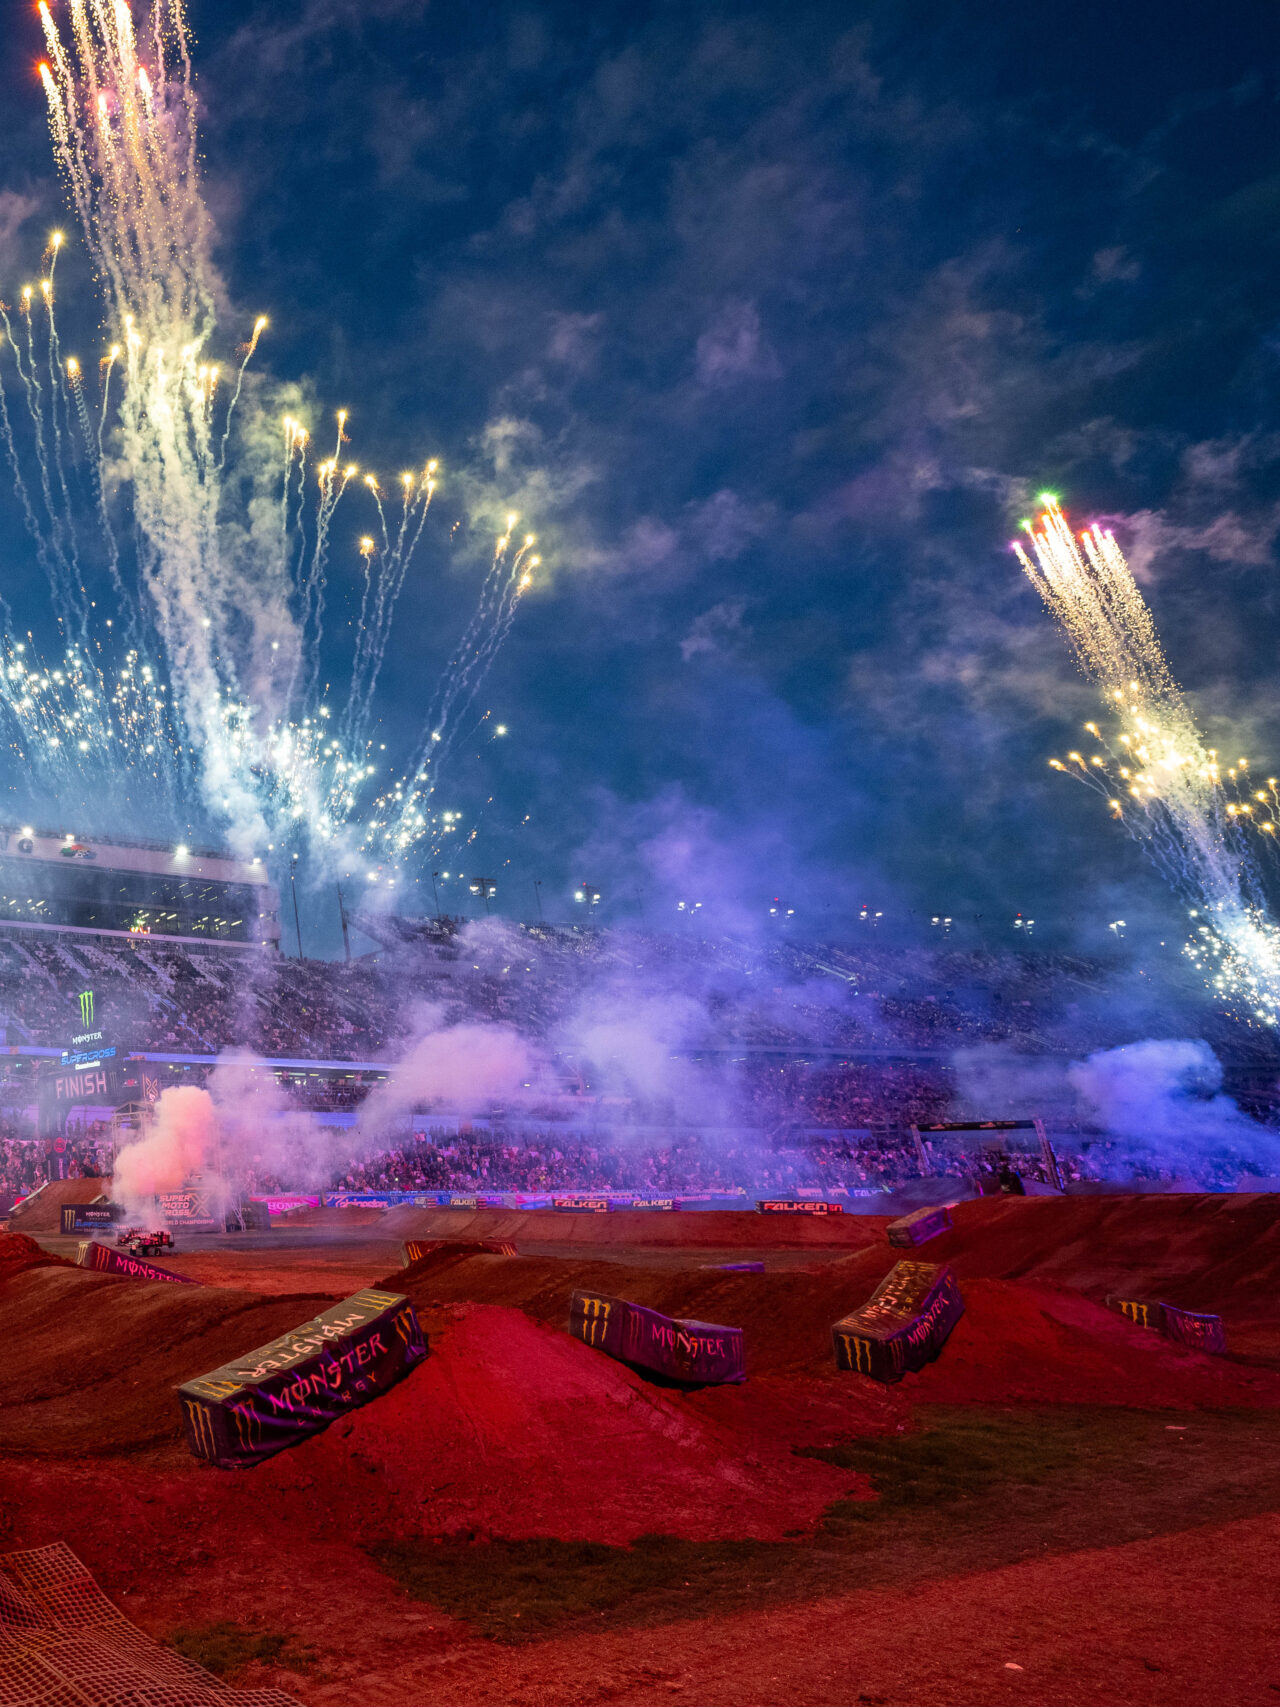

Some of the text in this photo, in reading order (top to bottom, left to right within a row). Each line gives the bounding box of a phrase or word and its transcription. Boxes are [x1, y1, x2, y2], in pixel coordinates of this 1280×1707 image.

[72, 1031, 103, 1044] MONSTER
[61, 1046, 117, 1066] SUPERCROSS
[56, 1070, 107, 1100] FINISH
[160, 1194, 190, 1202] SUPER
[162, 1201, 190, 1209] MOTO
[554, 1200, 607, 1209] FALKEN
[632, 1199, 673, 1207] FALKEN
[764, 1202, 827, 1211] FALKEN
[907, 1291, 950, 1347] MONSTER
[238, 1313, 365, 1378] MONSTER
[651, 1322, 726, 1359] MONSTER
[269, 1333, 389, 1415] MONSTER
